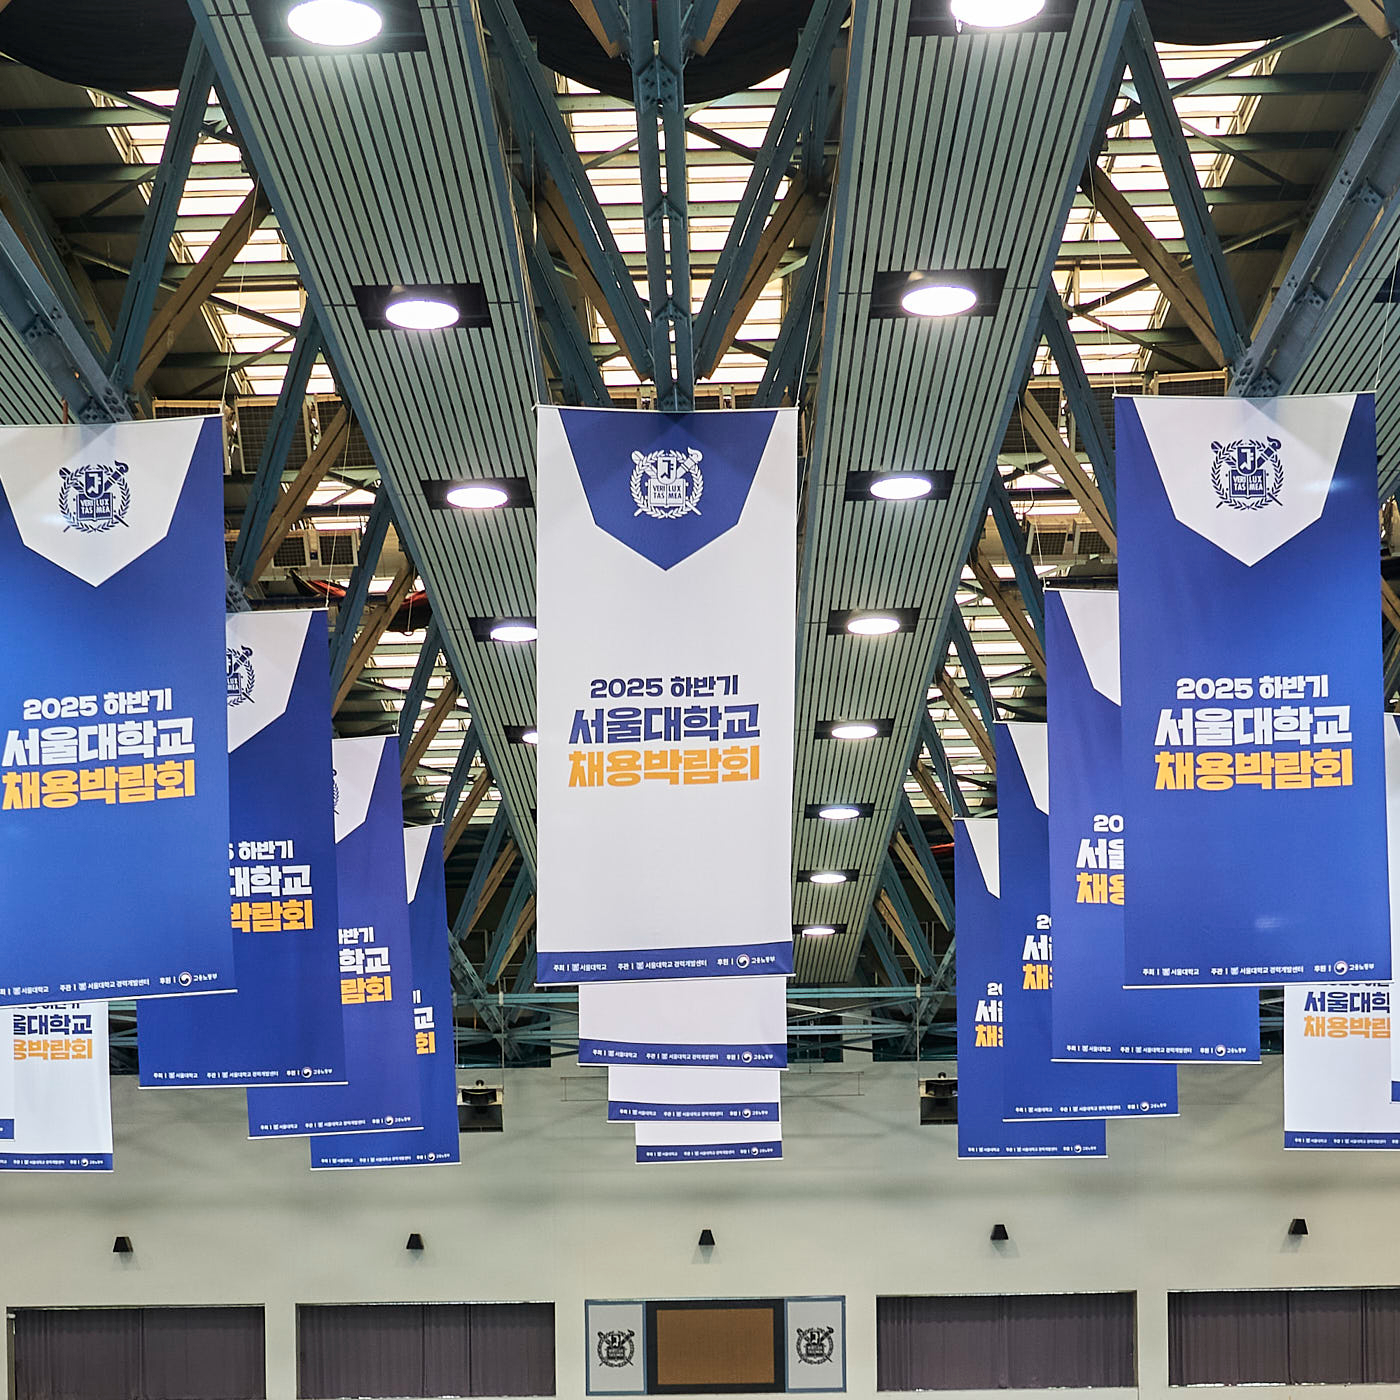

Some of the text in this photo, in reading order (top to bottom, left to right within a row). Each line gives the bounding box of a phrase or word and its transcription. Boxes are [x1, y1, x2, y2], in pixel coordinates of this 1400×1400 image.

[23, 688, 172, 716] 2025 하반기
[590, 674, 738, 698] 2025 하반기
[1177, 675, 1329, 700] 2025 하반기
[569, 704, 759, 744] 서울대학교
[1155, 705, 1351, 748] 서울대학교
[3, 718, 195, 767] 서울대학교
[569, 745, 760, 788] 채용박람회
[1155, 748, 1353, 790] 채용박람회
[3, 767, 195, 811] 채용박람회
[580, 963, 606, 971] 서울대학교
[645, 961, 672, 969] 서울대학교
[717, 958, 728, 966] 후원
